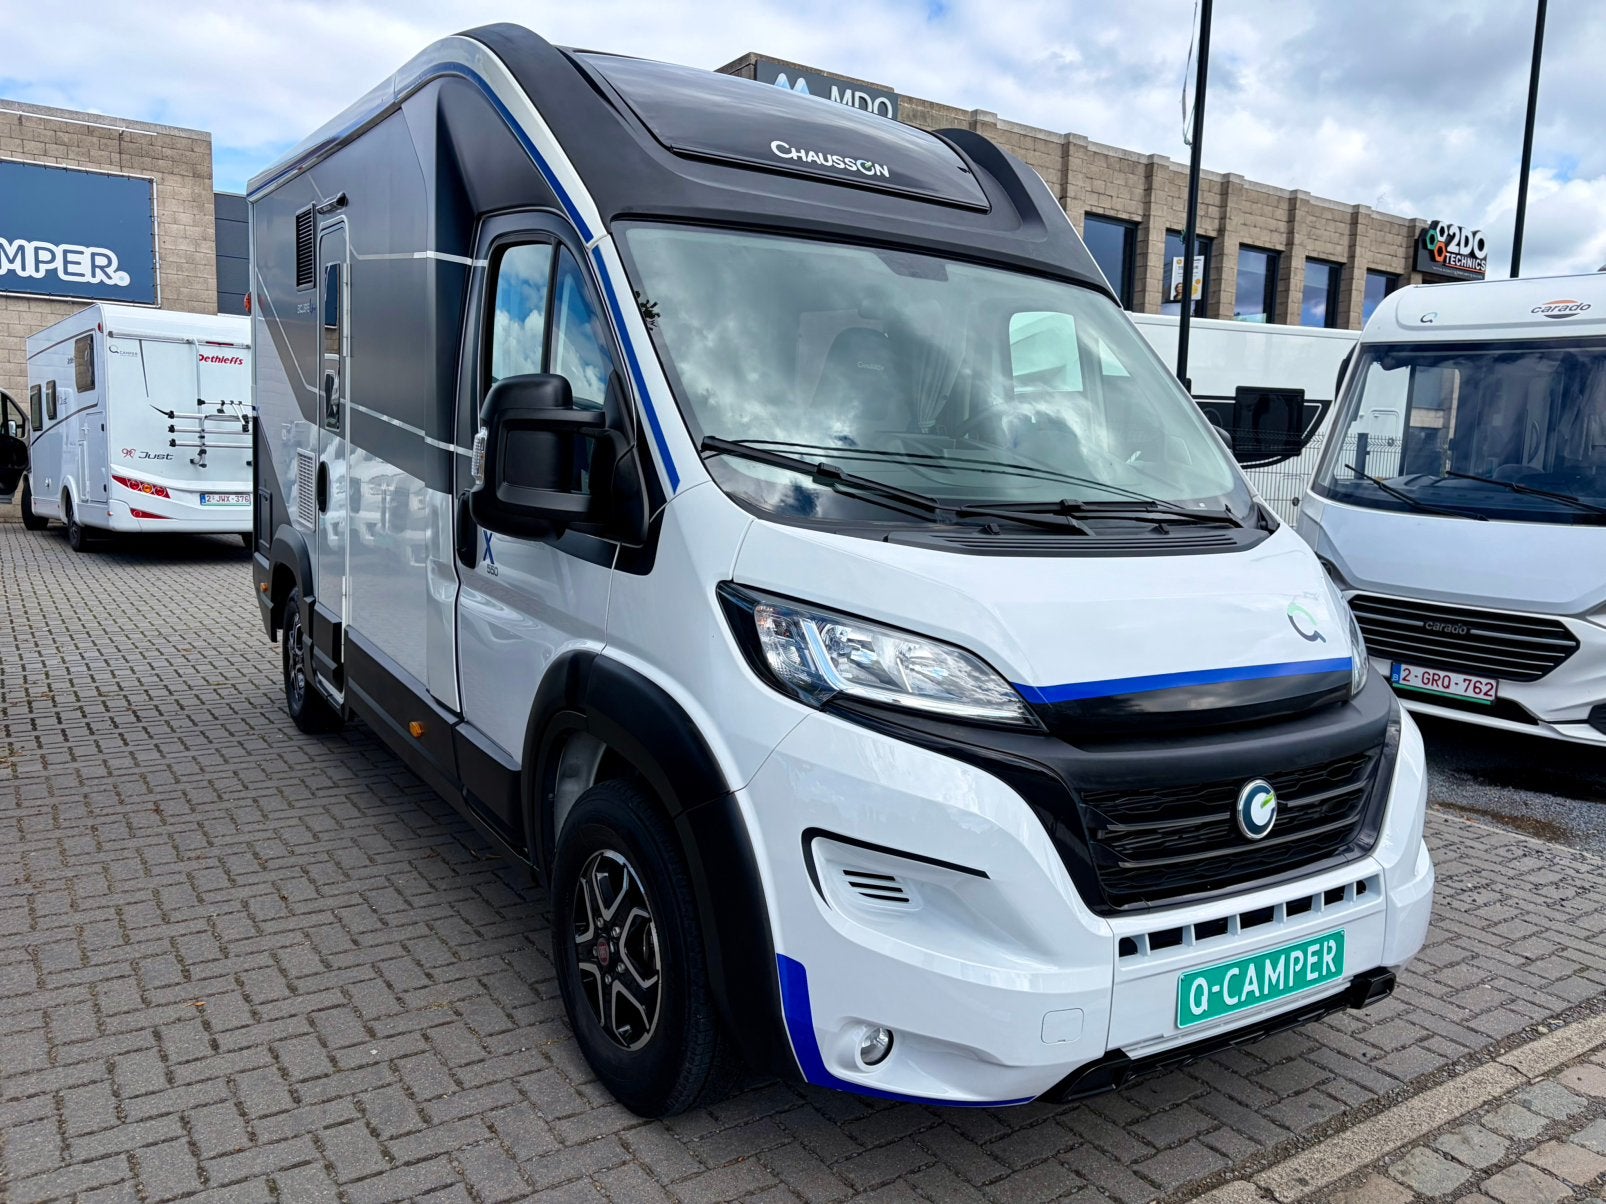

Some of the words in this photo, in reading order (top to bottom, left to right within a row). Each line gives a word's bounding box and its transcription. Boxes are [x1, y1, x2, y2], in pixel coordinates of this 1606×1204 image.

[1445, 252, 1487, 271] TECHNICS
[1531, 302, 1592, 314] carado
[138, 451, 174, 460] Just
[1425, 621, 1468, 635] carado
[1401, 667, 1494, 698] 2-GRQ-762
[1189, 938, 1337, 1016] Q-CAMPER
